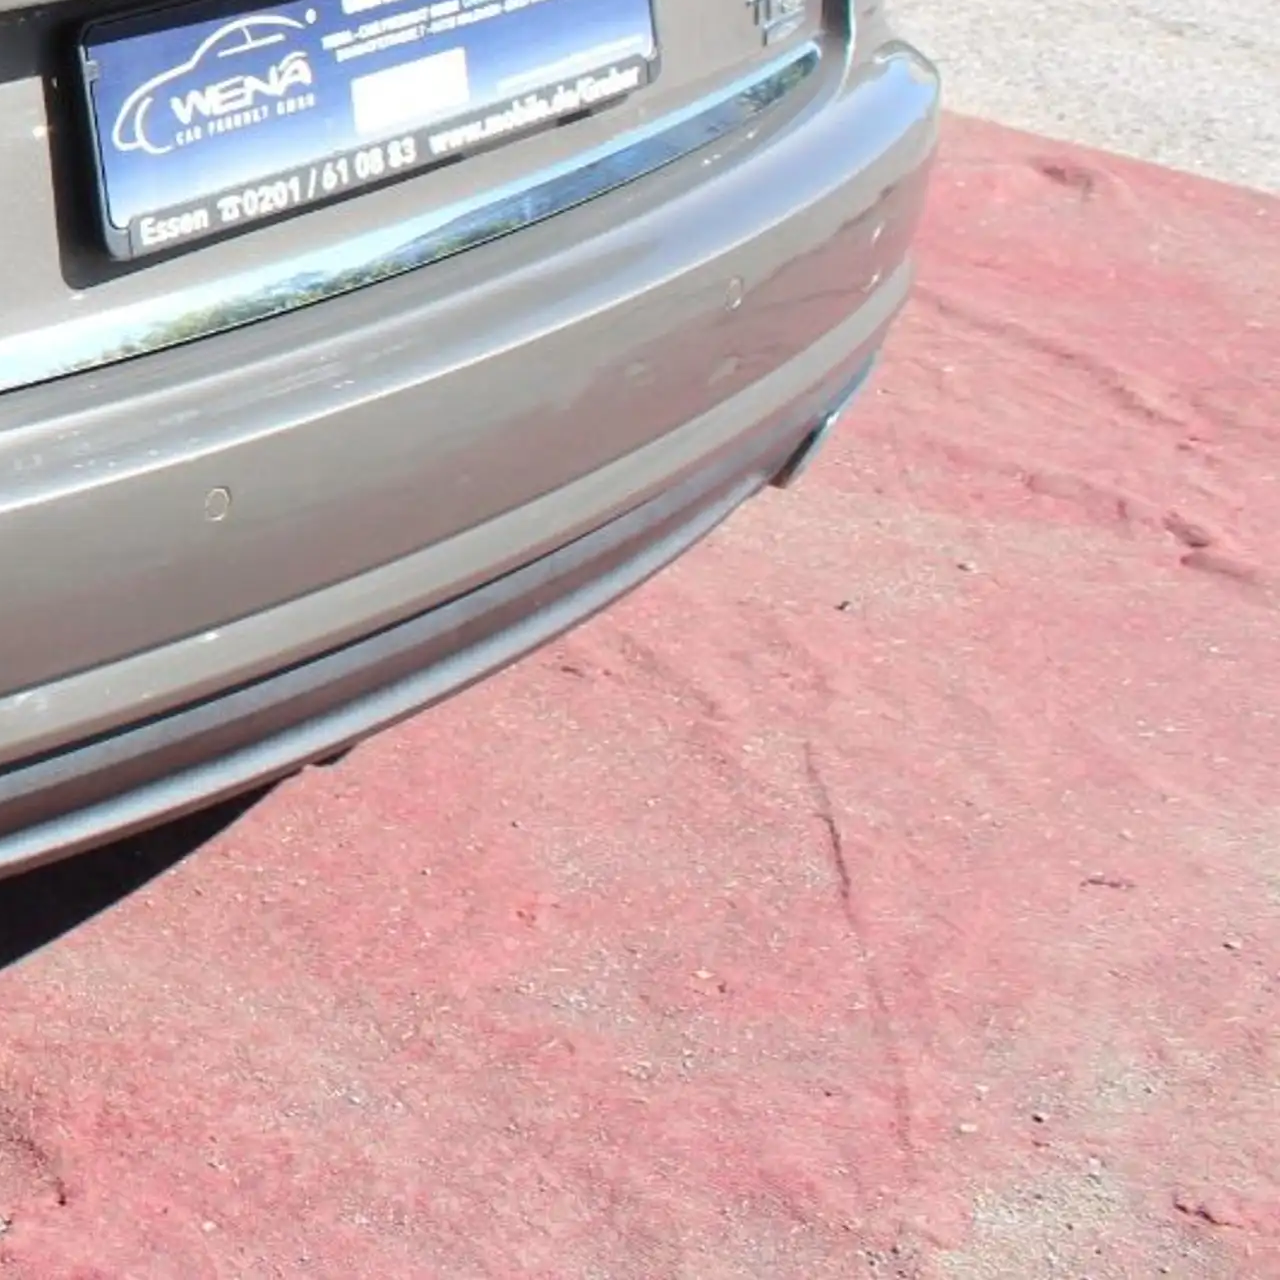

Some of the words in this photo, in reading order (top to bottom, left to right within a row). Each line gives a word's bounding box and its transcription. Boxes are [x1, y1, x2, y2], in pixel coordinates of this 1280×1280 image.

[140, 207, 209, 246] Essen
[322, 158, 349, 191] 61
[387, 136, 417, 168] 83
